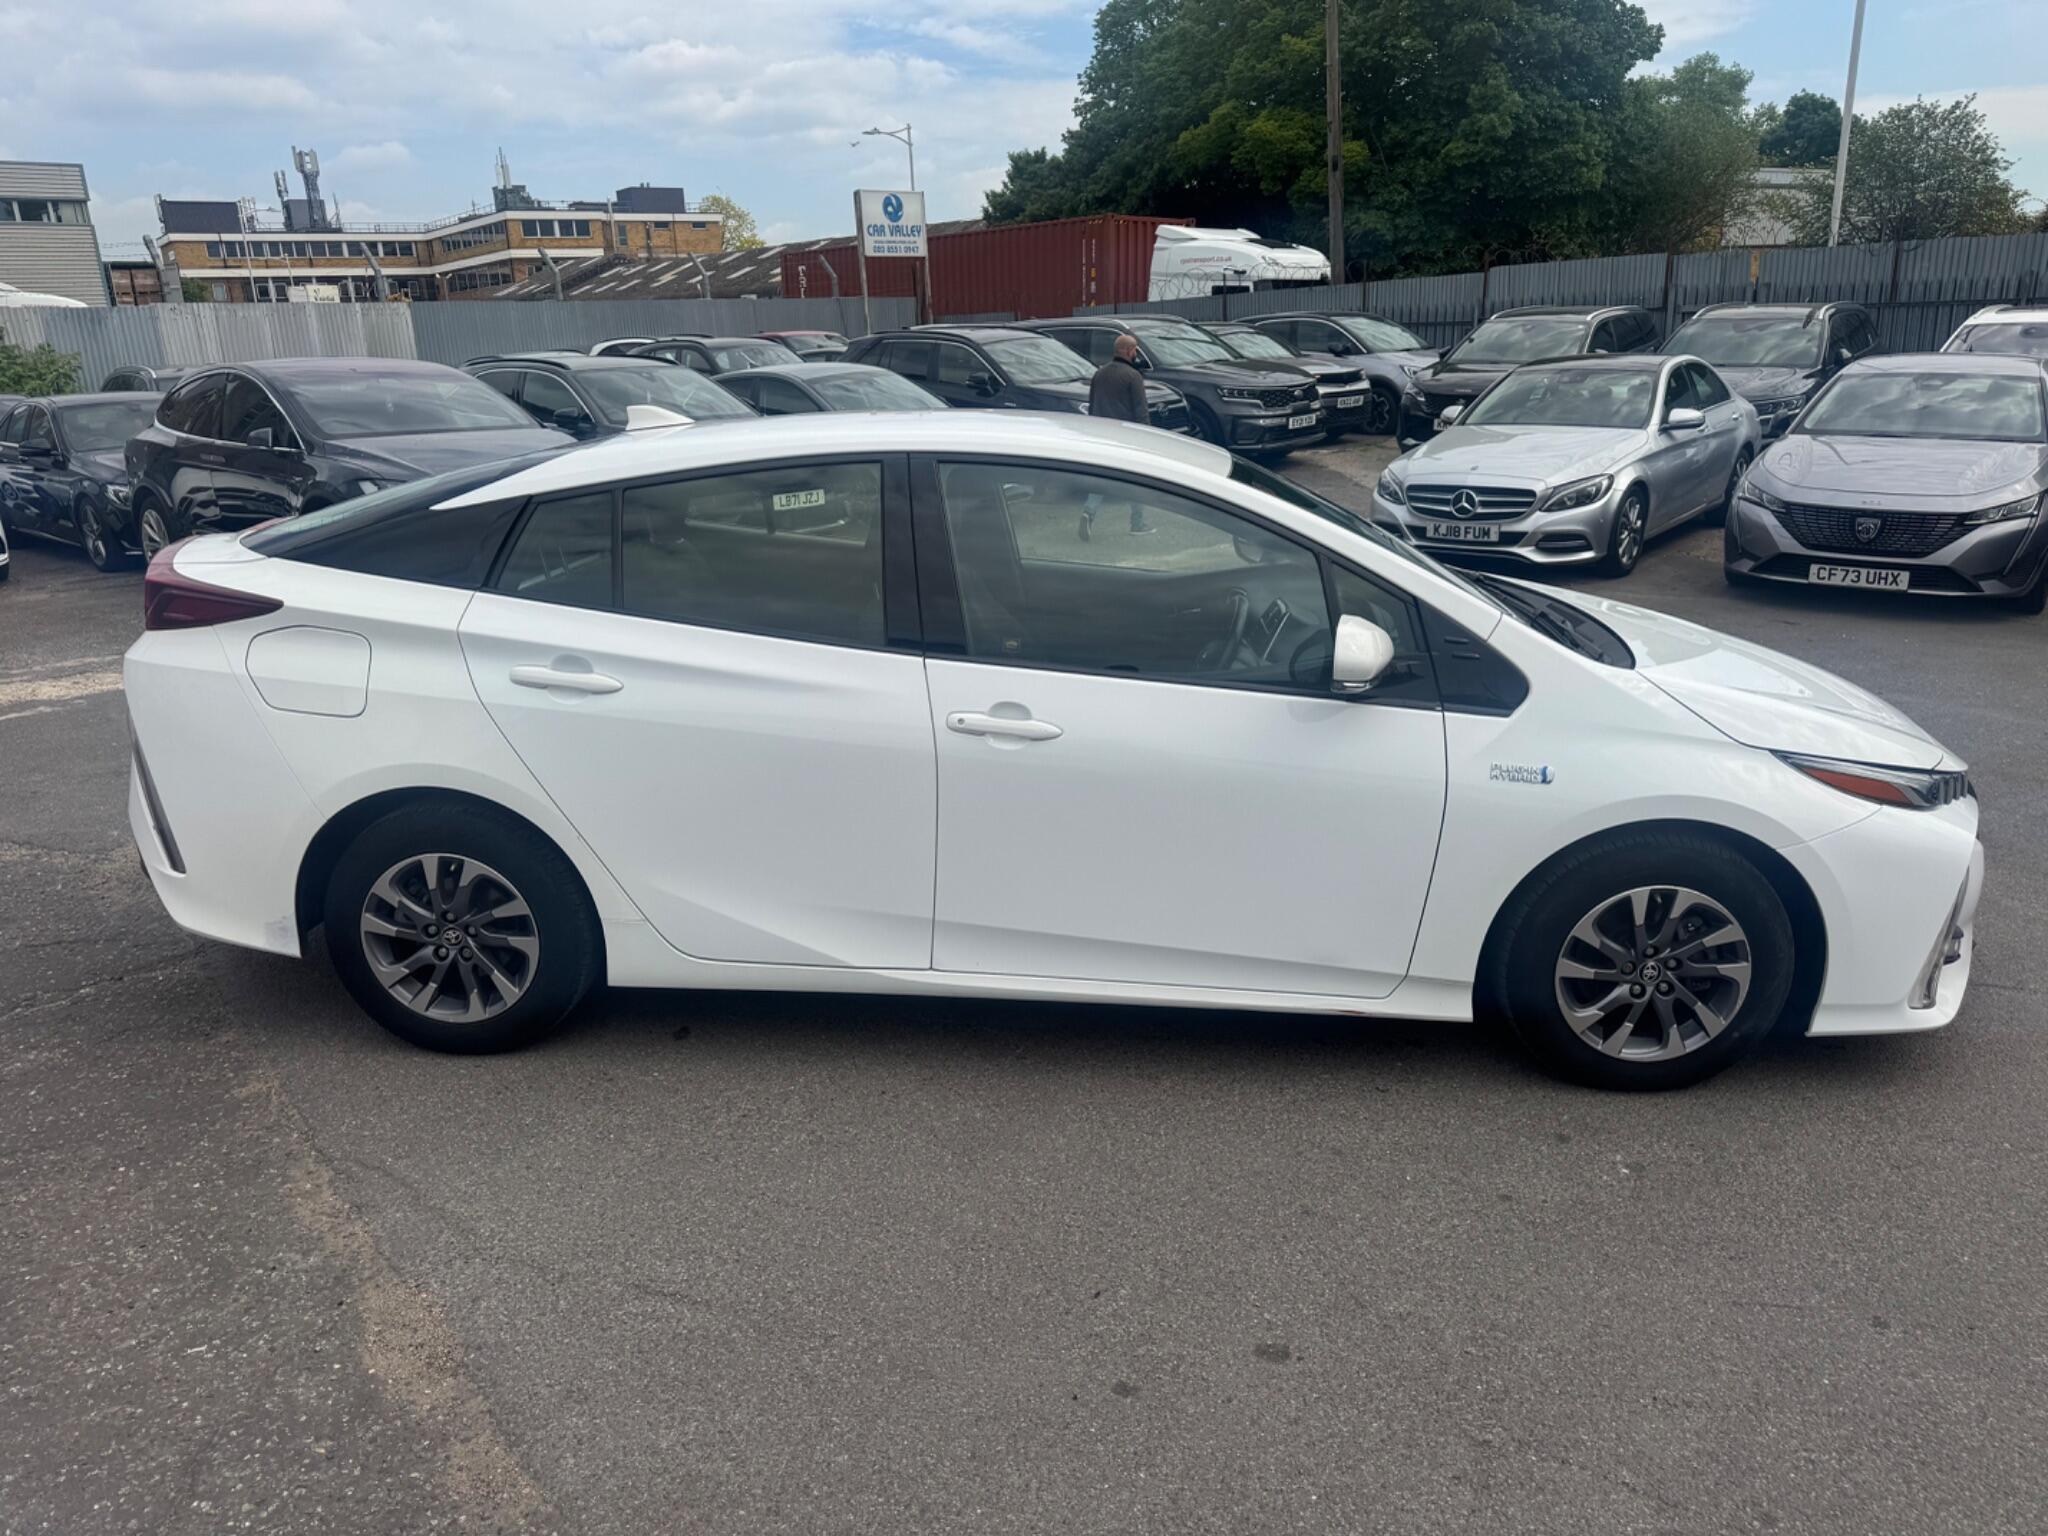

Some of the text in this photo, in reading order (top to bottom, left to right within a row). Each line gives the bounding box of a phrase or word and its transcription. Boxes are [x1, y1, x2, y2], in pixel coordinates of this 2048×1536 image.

[867, 224, 921, 237] CAR VALLEY
[779, 491, 819, 507] LB71 JZJ
[1433, 523, 1491, 539] KJ18 FUM
[1816, 567, 1901, 586] CF73 UHX
